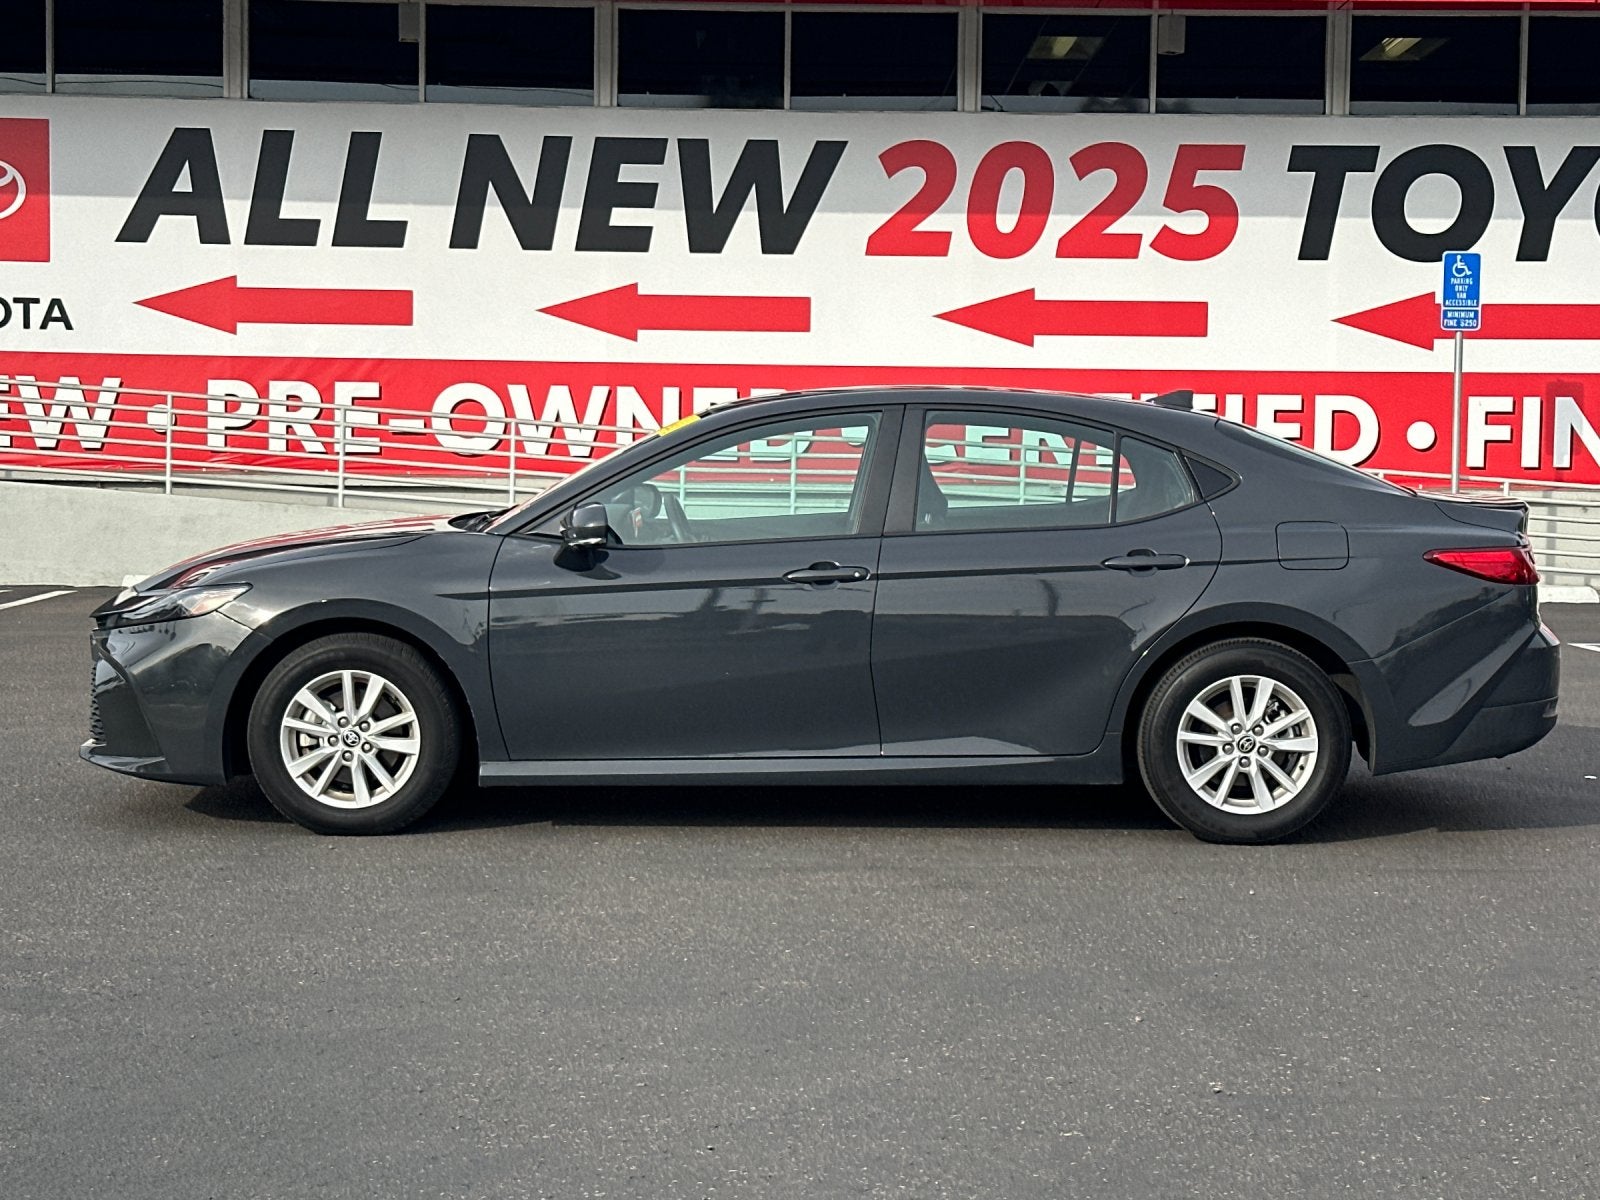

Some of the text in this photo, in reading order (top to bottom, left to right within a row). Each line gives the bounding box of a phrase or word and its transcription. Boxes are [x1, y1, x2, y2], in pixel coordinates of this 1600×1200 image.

[115, 127, 1600, 263] ALL NEW 2025 TOY
[1450, 277, 1473, 285] PARKING
[1443, 319, 1477, 327] FINE $250
[0, 374, 122, 449] W
